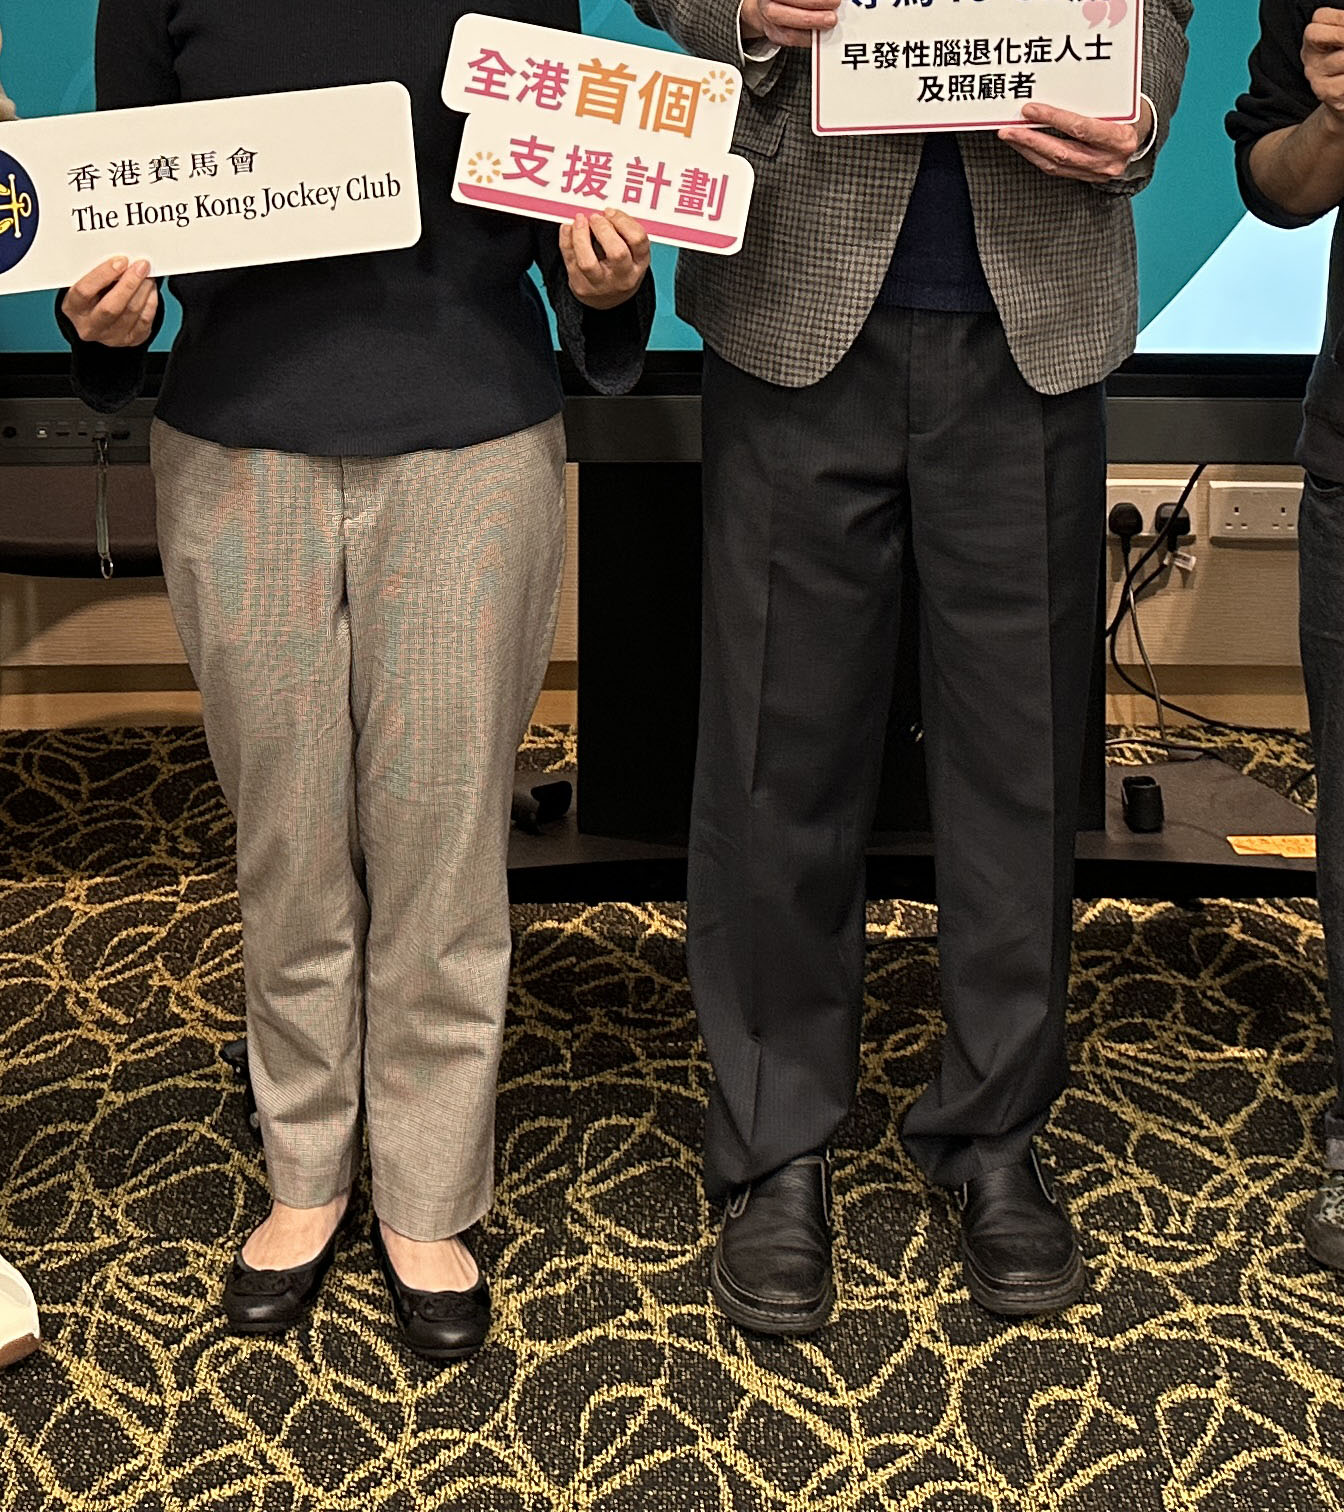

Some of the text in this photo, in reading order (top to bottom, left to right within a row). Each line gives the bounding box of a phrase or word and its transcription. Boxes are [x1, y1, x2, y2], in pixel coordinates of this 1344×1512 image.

[841, 33, 1113, 70] 早發性腦退化症人士
[464, 47, 703, 138] 全港首個
[916, 71, 1037, 103] 及照顧者
[67, 146, 259, 193] 香港賽馬會
[501, 134, 729, 222] 支援計劃
[71, 172, 402, 233] The Hong Kong Jockey Club
